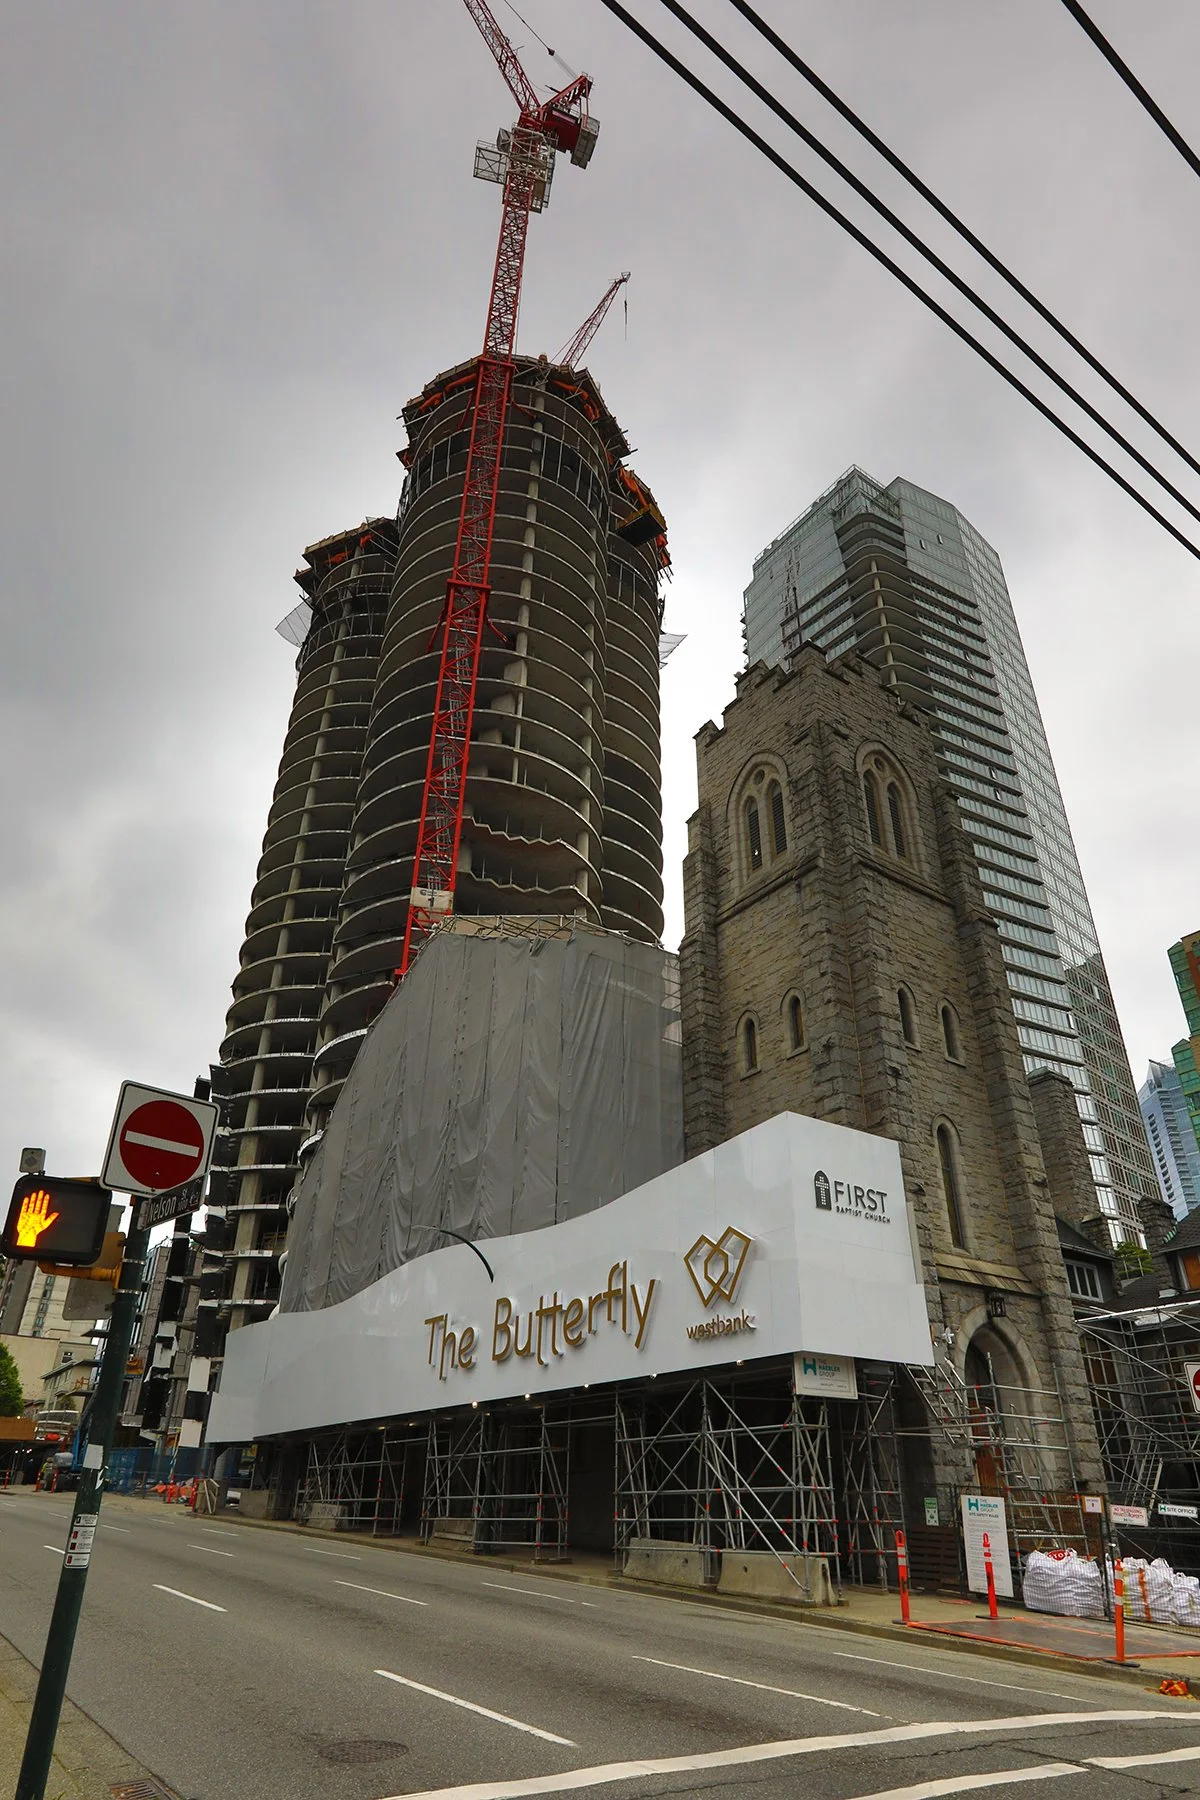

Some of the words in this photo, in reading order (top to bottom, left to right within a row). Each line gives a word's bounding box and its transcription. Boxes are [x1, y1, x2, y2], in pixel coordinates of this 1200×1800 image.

[148, 1196, 177, 1223] Nelson
[834, 1180, 887, 1214] FIRST
[836, 1205, 863, 1218] BAPTIST
[864, 1211, 891, 1224] CHURCH
[424, 1313, 478, 1381] The
[492, 1260, 660, 1366] Butterfly
[686, 1309, 754, 1340] westbank
